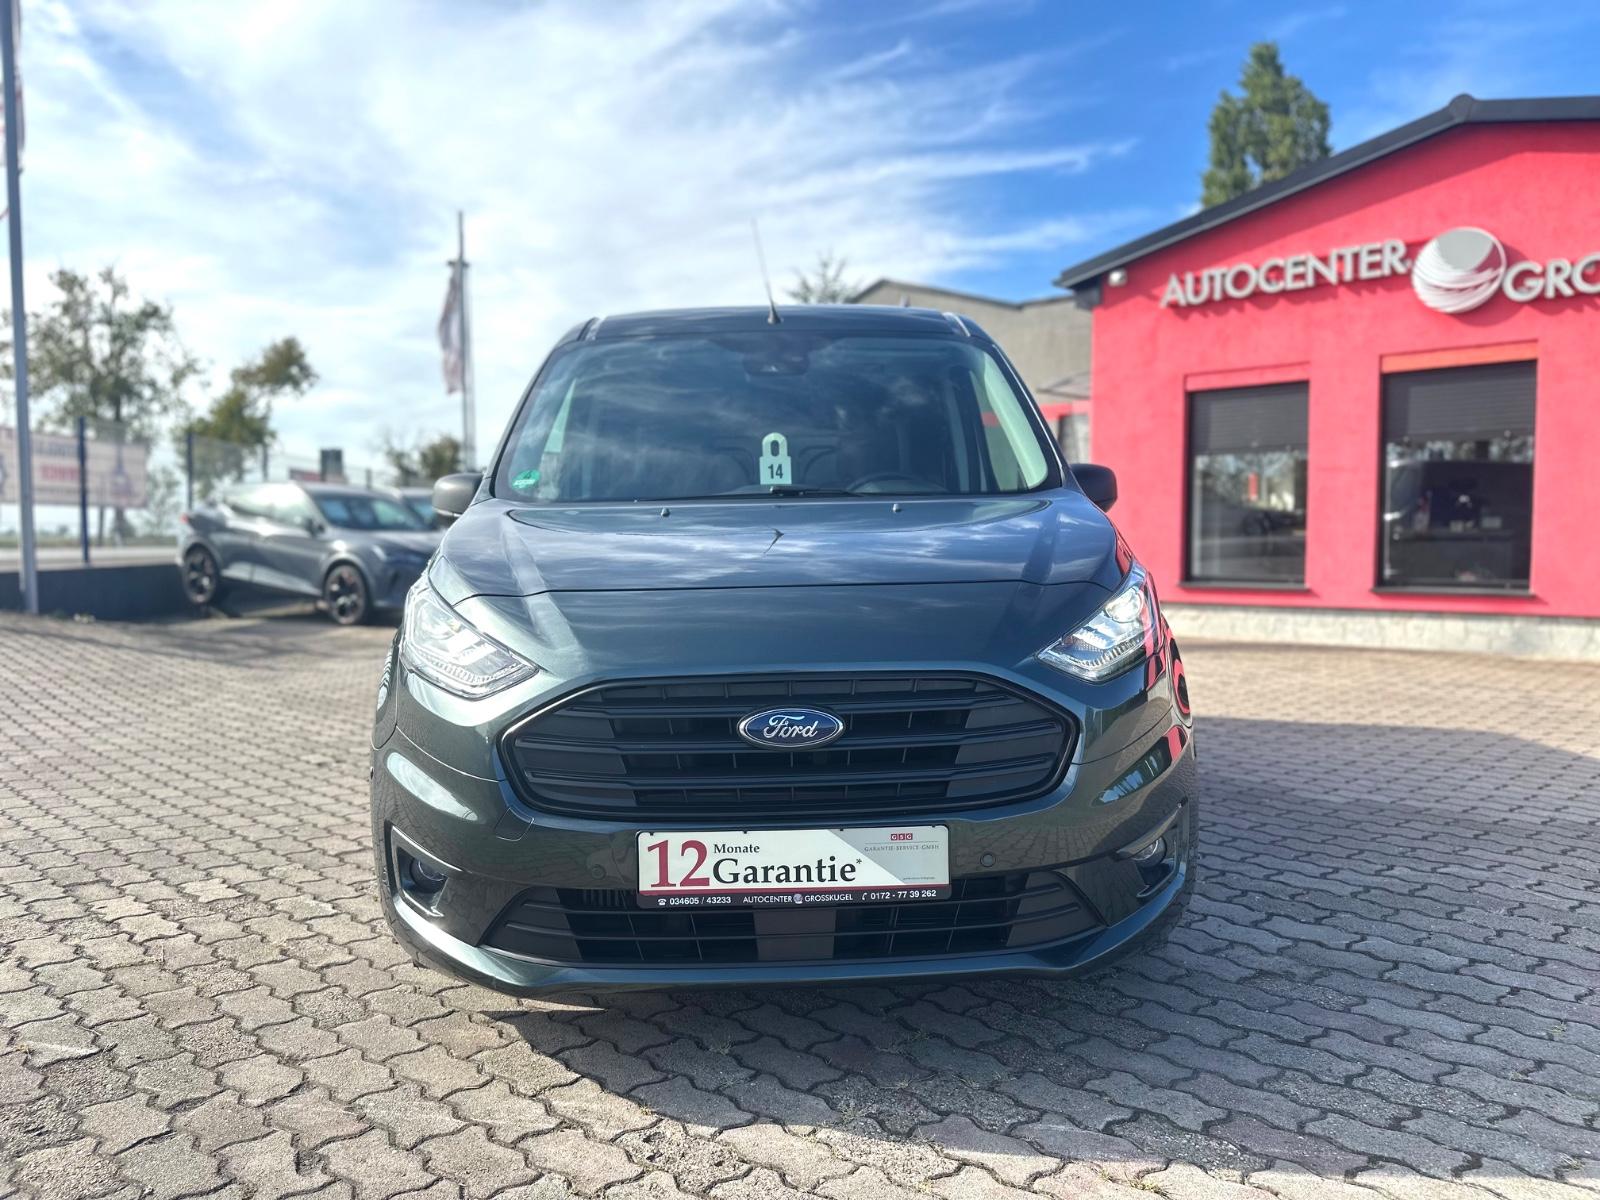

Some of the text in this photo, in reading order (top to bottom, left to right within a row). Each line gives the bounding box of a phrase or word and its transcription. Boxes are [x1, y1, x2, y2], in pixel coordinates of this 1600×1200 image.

[1160, 239, 1409, 309] AUTOCENTER
[768, 463, 783, 480] 14
[763, 714, 818, 739] Ford
[713, 843, 760, 854] Monate
[647, 839, 711, 888] 12
[669, 897, 700, 905] 034605
[706, 896, 732, 904] 43233
[743, 894, 853, 903] AUTOCENTER GROSSKUGEL
[870, 892, 890, 900] 0172
[897, 891, 908, 899] 77
[921, 889, 937, 898] 262
